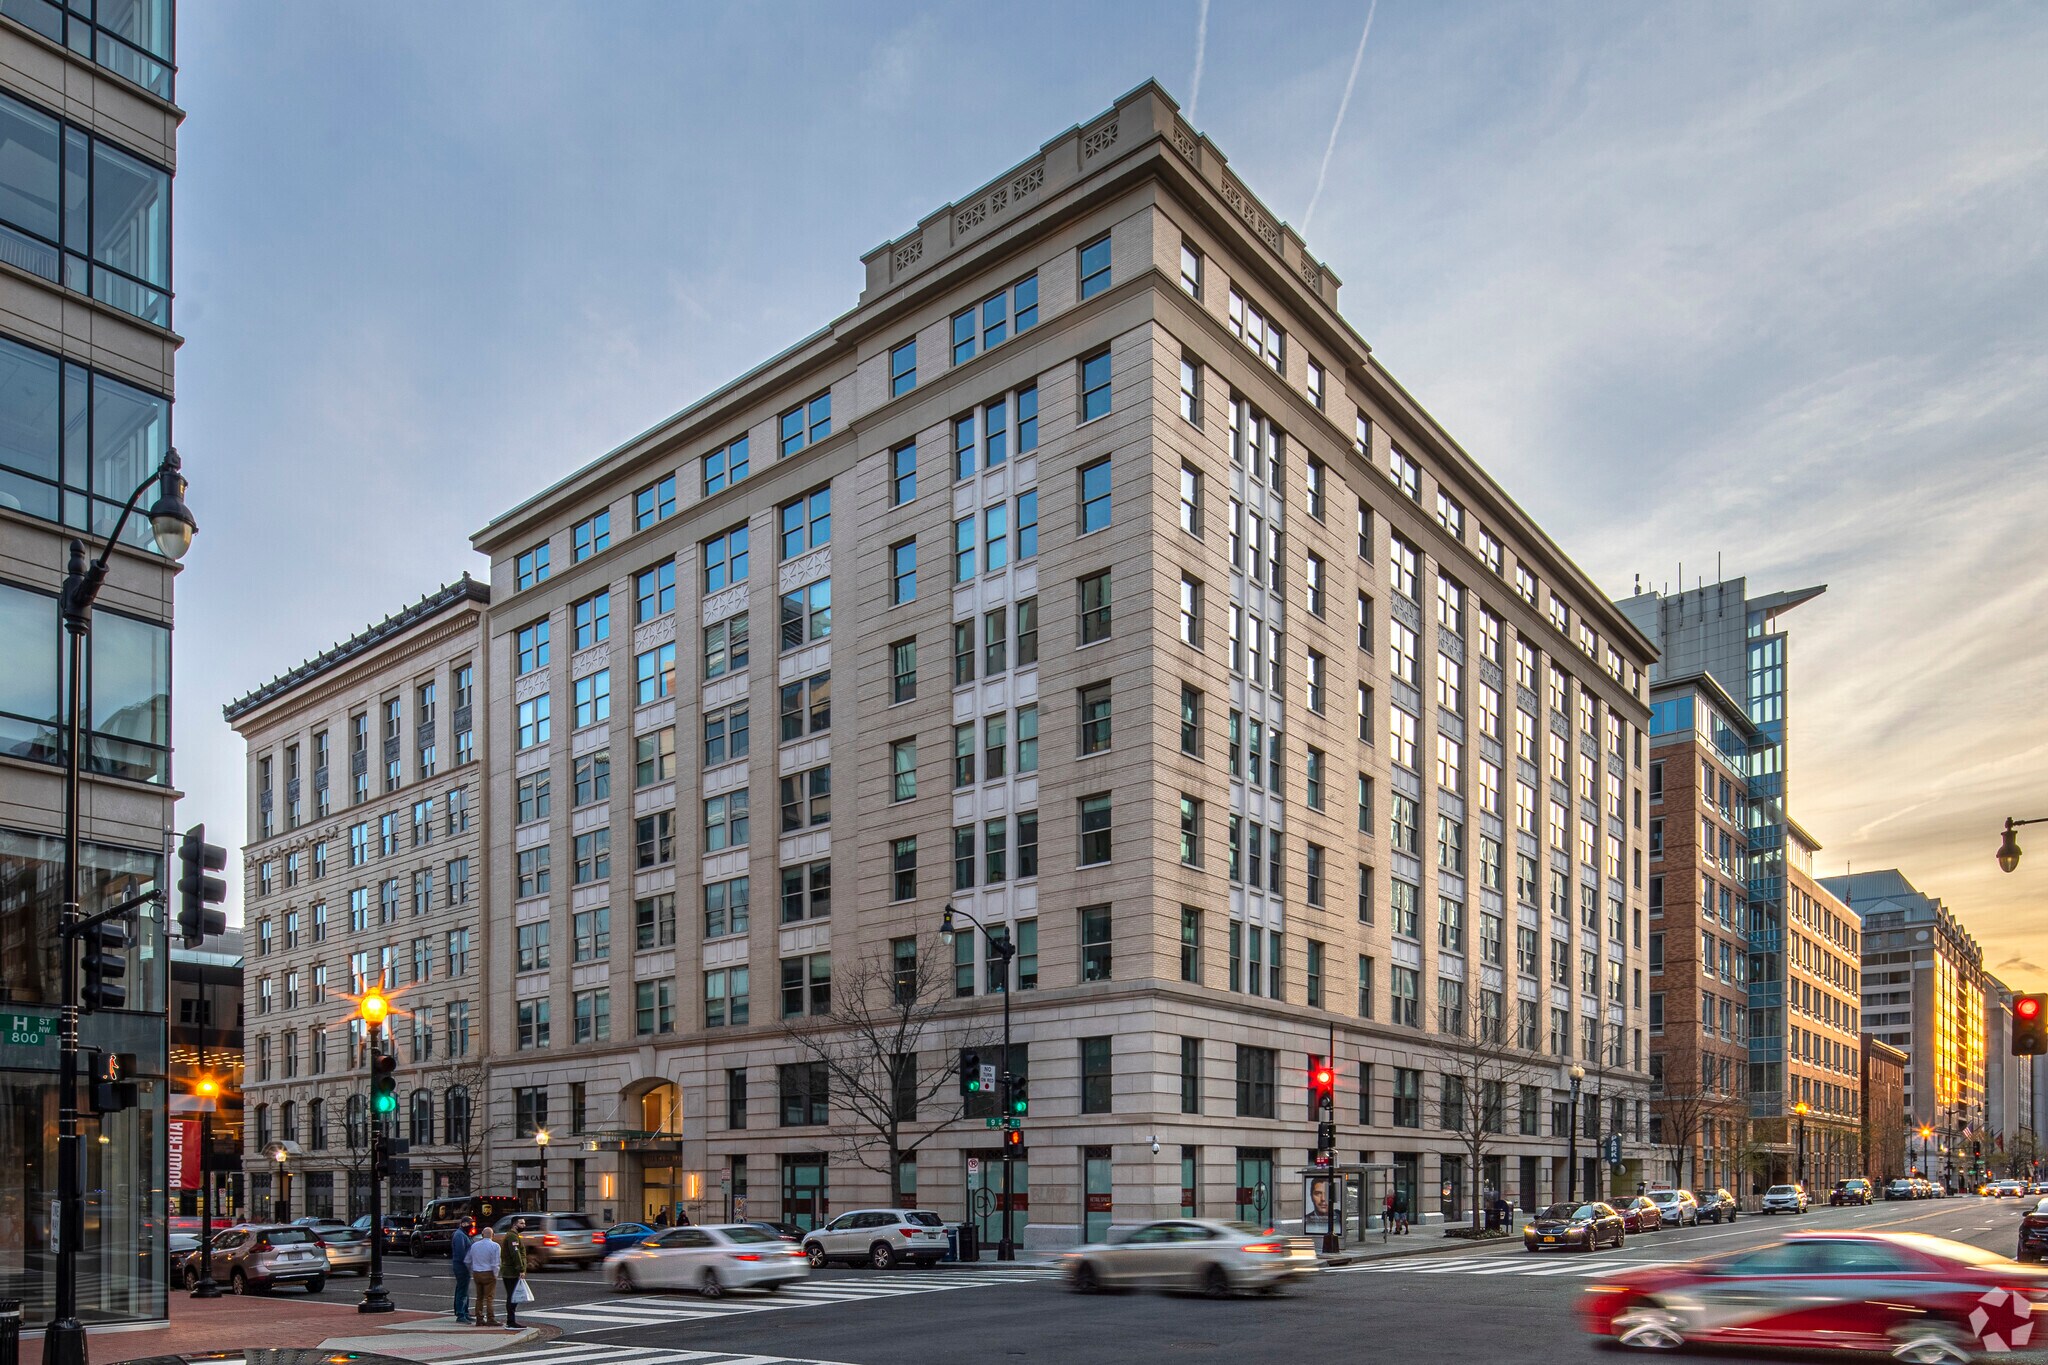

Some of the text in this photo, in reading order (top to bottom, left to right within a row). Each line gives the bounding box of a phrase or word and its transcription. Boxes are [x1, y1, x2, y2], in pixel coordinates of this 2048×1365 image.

[13, 1016, 51, 1031] H ST
[38, 1026, 51, 1034] NW
[11, 1032, 38, 1044] 800
